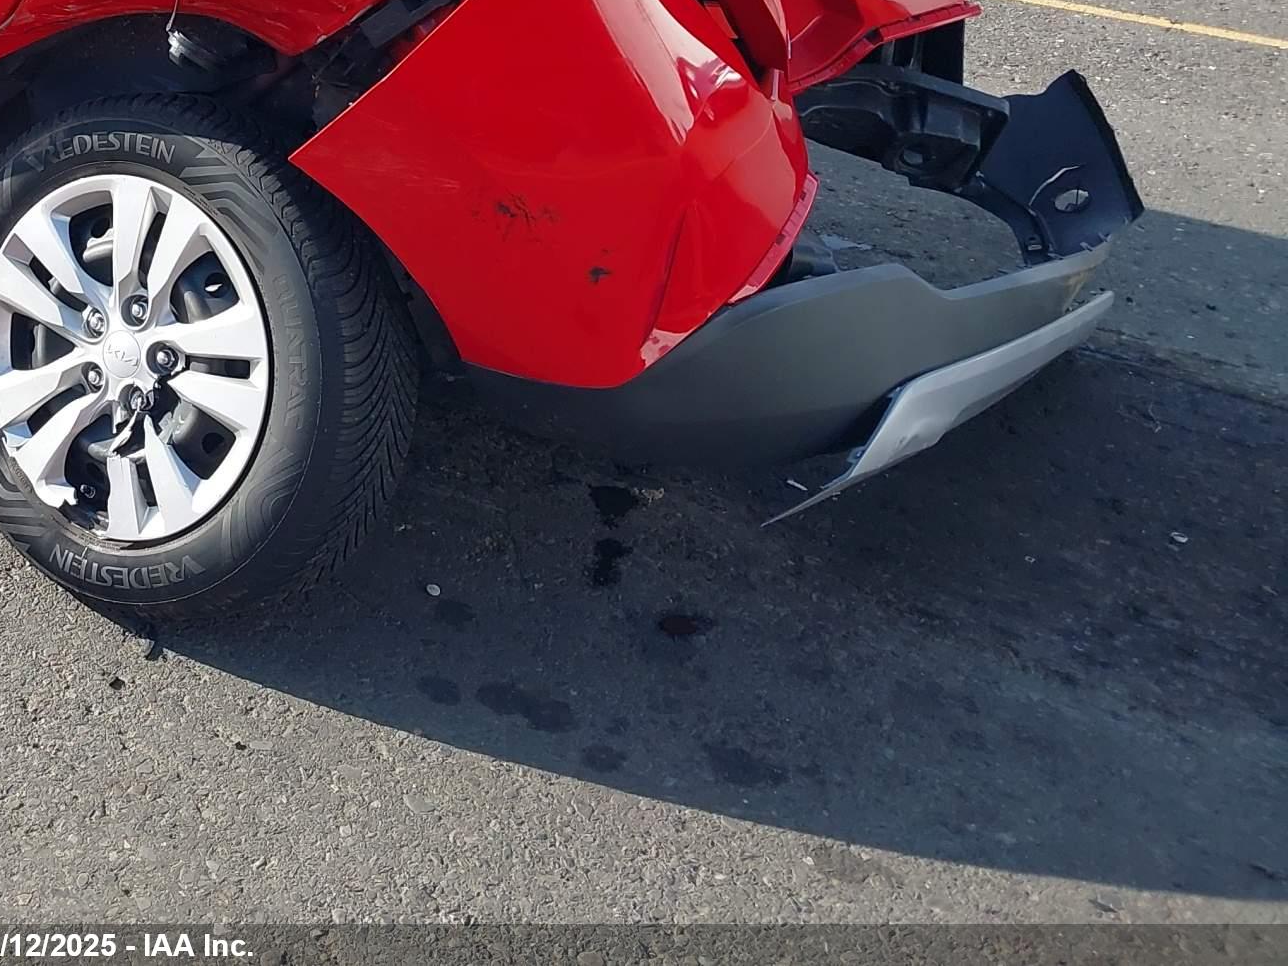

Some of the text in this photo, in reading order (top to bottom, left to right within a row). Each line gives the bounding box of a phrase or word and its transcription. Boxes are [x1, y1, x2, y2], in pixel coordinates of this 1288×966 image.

[23, 131, 176, 173] VREDESTEIN
[272, 273, 307, 430] QUATRAC
[49, 543, 206, 590] VREDESTEIN
